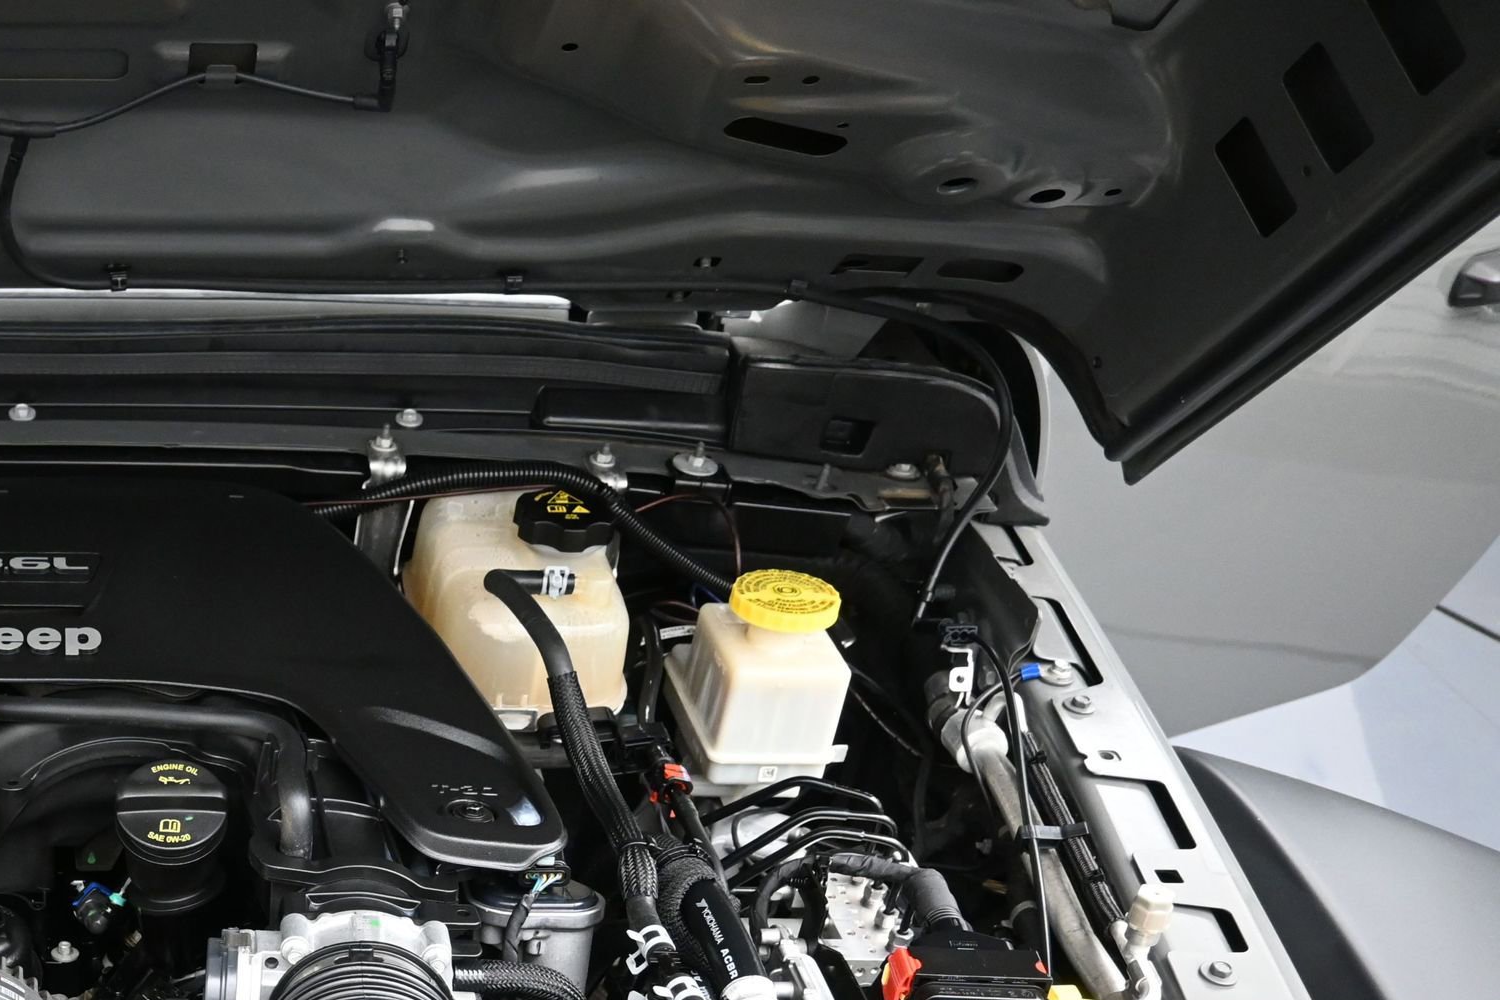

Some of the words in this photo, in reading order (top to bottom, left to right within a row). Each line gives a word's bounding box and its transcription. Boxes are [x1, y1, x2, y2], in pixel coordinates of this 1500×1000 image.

[150, 763, 184, 773] ENGINE
[185, 765, 198, 776] OIL
[147, 831, 165, 842] SAE
[701, 906, 724, 945] YOKOHAMA
[720, 948, 739, 979] ACBR
